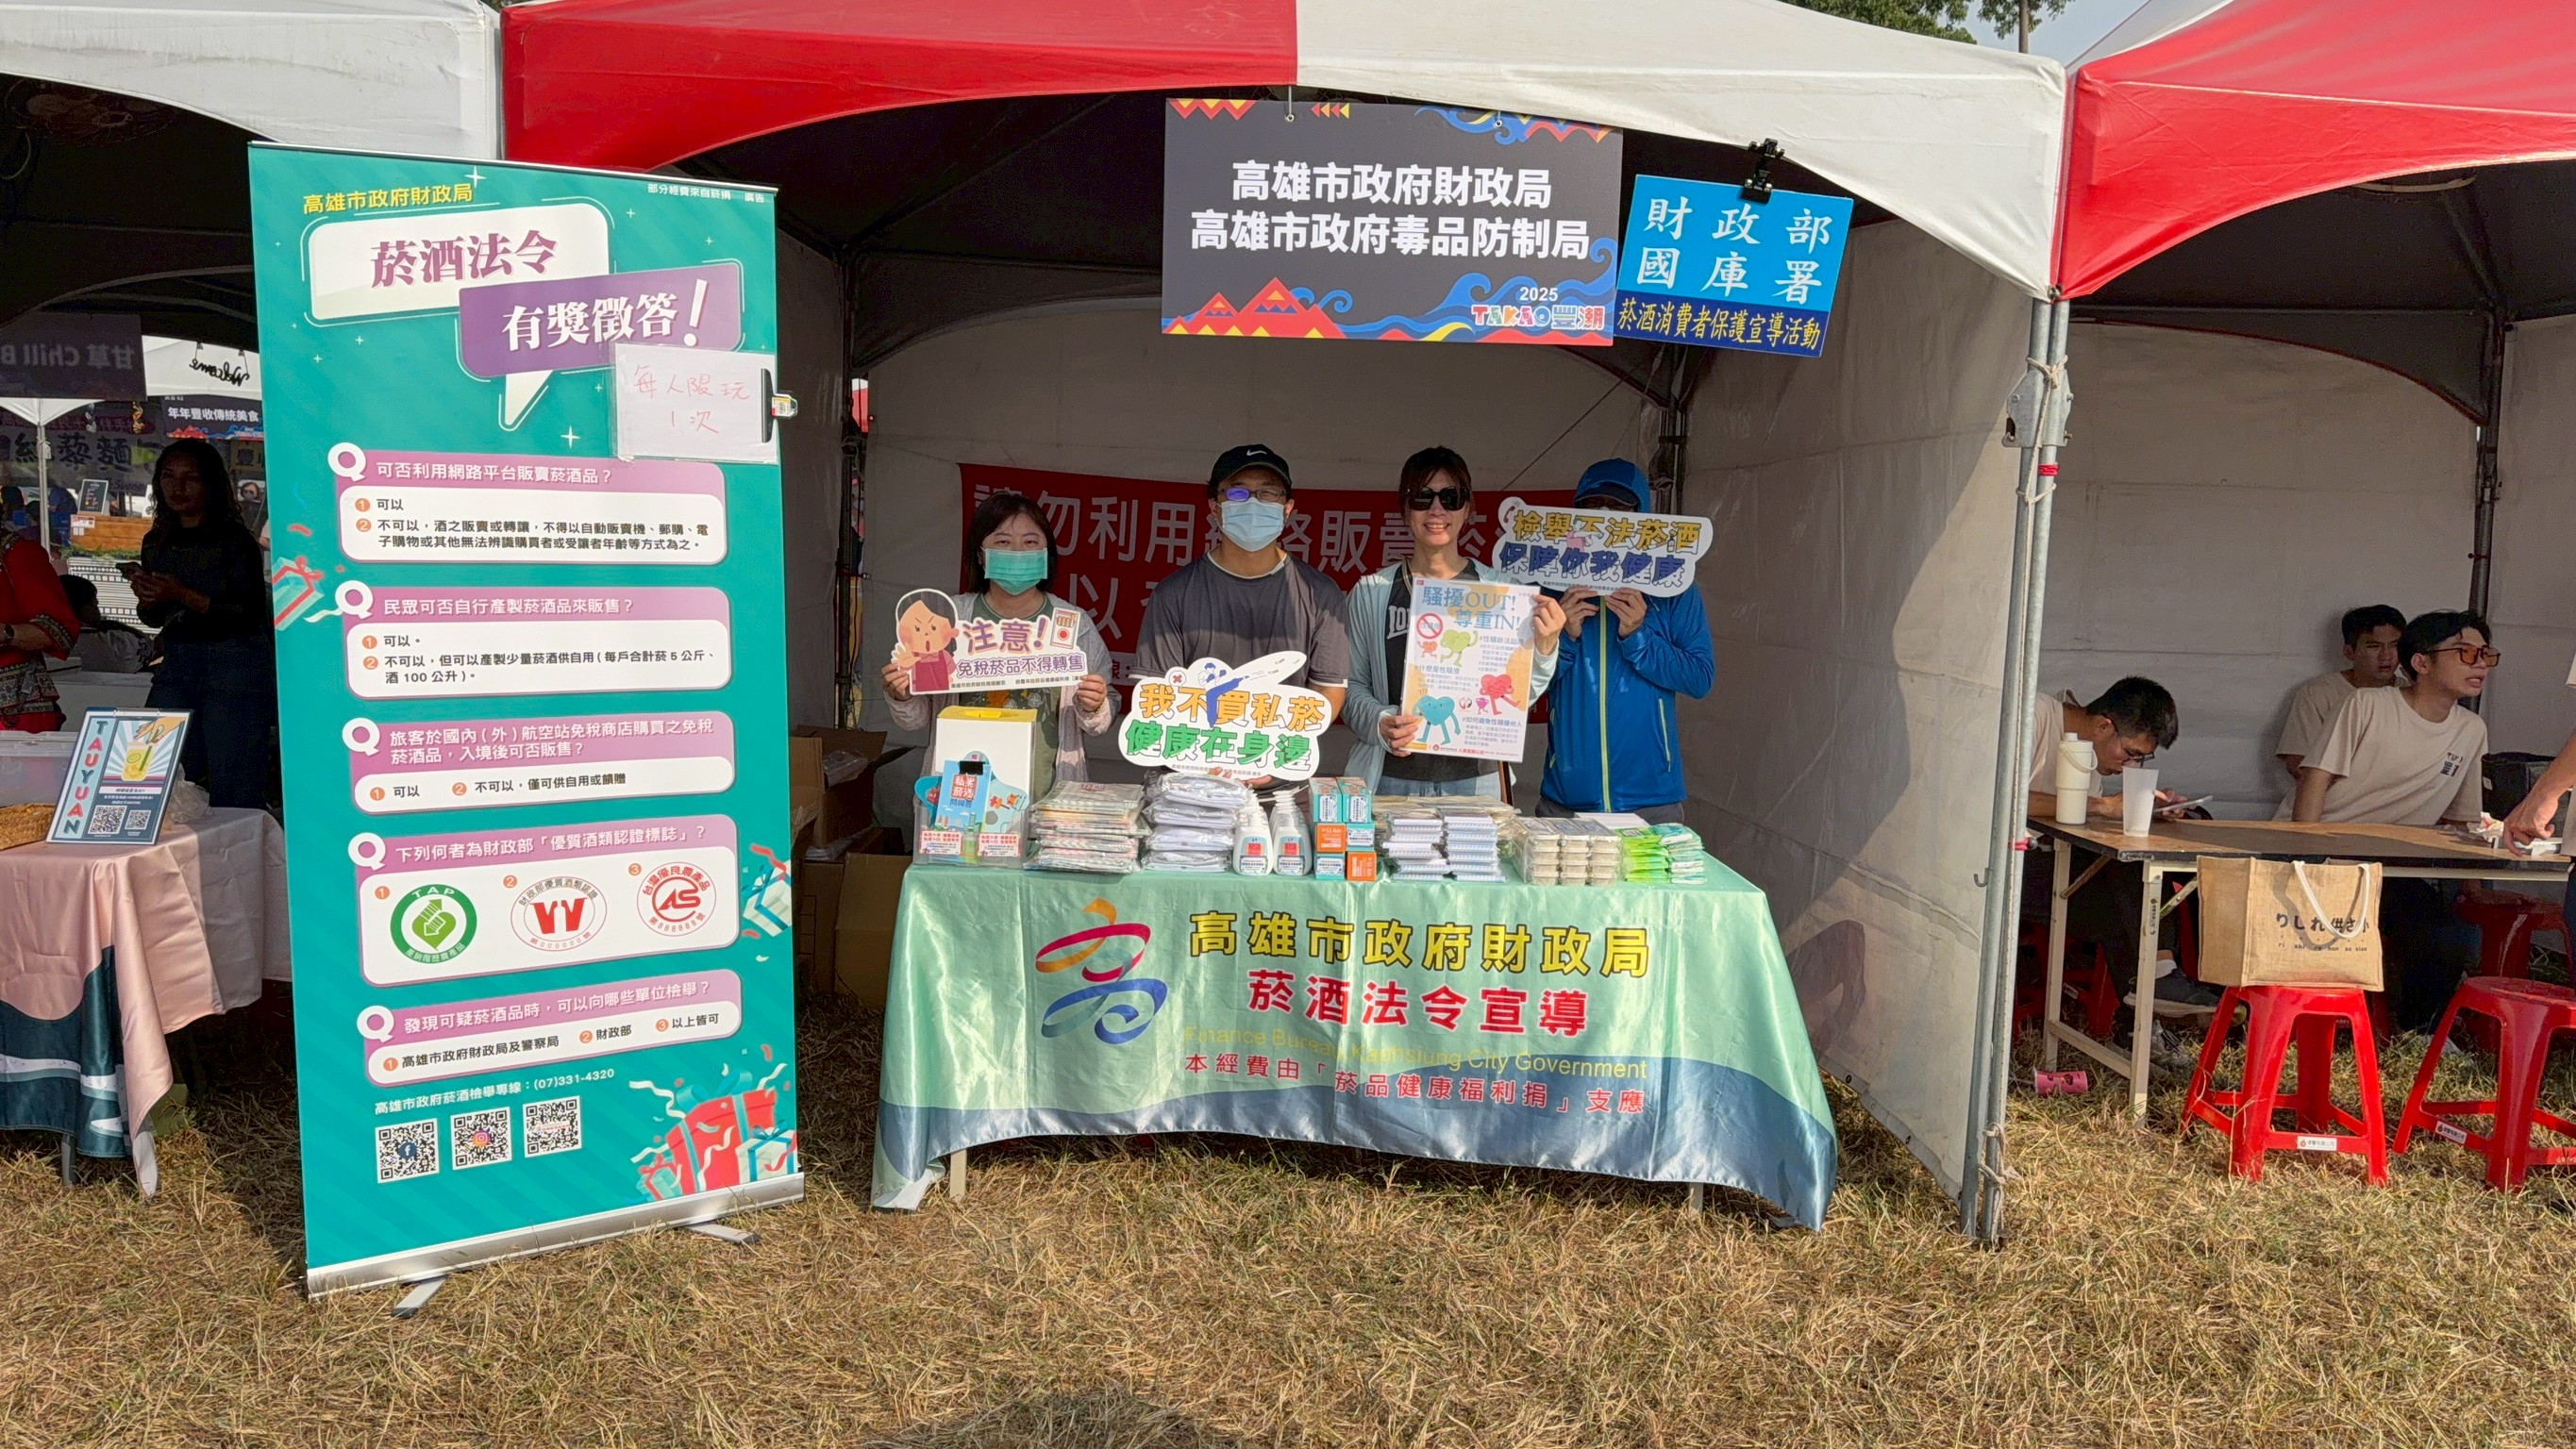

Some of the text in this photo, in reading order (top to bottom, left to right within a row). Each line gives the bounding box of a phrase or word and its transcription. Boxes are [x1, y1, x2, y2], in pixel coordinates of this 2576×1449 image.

[303, 183, 474, 214] 高雄市政府財政局
[744, 192, 765, 203] 廣告
[1231, 159, 1552, 208] 高雄市政府財政局
[1191, 208, 1590, 259] 高雄市政府毒品防制局
[1644, 196, 1832, 254] 財政部
[370, 229, 558, 289] 菸酒法令
[1636, 247, 1822, 305] 國庫署
[1519, 287, 1559, 302] 2025
[1616, 297, 1821, 350] 菸酒消費者保護宣導活動
[633, 364, 750, 400] 每人限玩
[168, 407, 259, 422] 年年豐收傳統美食
[327, 442, 366, 481] Q
[376, 461, 611, 484] 可否利用網路平台販賣菸酒品?
[376, 499, 404, 511] 可以
[1513, 509, 1702, 555] 檢舉不法菸酒
[1498, 541, 1686, 589] 保障你我健康
[335, 580, 374, 619] Q
[384, 598, 633, 616] 民眾可否自行產製菸酒品來販售?
[962, 617, 1048, 655] 注意!
[957, 654, 1084, 678] 免稅菸品不得轉售
[1139, 682, 1326, 732] 我不買私菸
[343, 717, 380, 756] Q
[1125, 719, 1312, 771] 健康在身邊
[63, 721, 109, 835] TAUYUAN
[393, 785, 420, 798] 可以
[348, 832, 386, 871] Q
[411, 887, 455, 899] TAP
[1190, 910, 1649, 977] 高雄市政府財政局
[1247, 969, 1588, 1037] 菸酒法令宣導
[357, 1005, 394, 1042] Q
[402, 1035, 560, 1069] 高雄市政府財政局及警察局
[596, 1024, 632, 1041] 財政部
[672, 1013, 719, 1029] 以上皆可
[1184, 1025, 1266, 1046] Finance
[1468, 1048, 1511, 1074] City
[1514, 1052, 1648, 1078] Government
